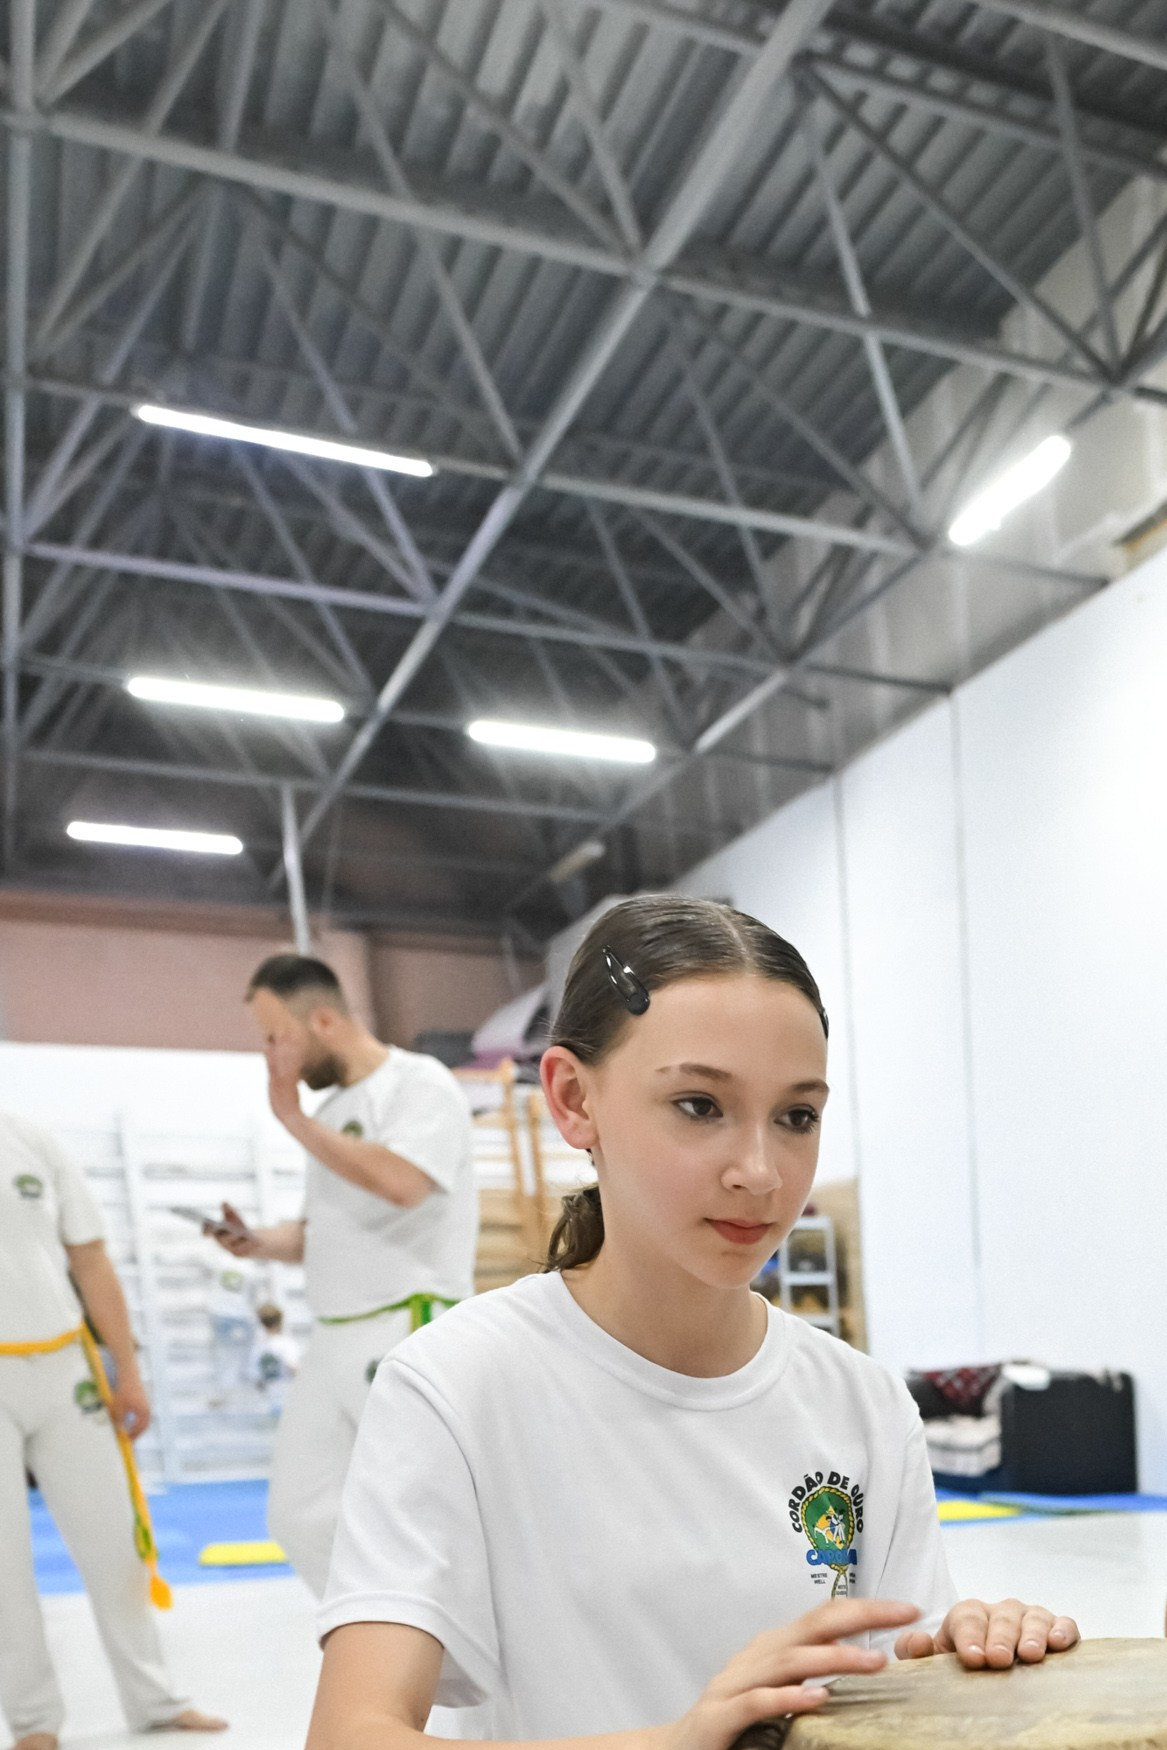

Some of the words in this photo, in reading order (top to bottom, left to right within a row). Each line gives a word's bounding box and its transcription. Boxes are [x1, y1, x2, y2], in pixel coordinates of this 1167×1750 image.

[788, 1471, 824, 1533] CORDÃO
[827, 1471, 850, 1490] DE
[851, 1484, 864, 1533] OURO
